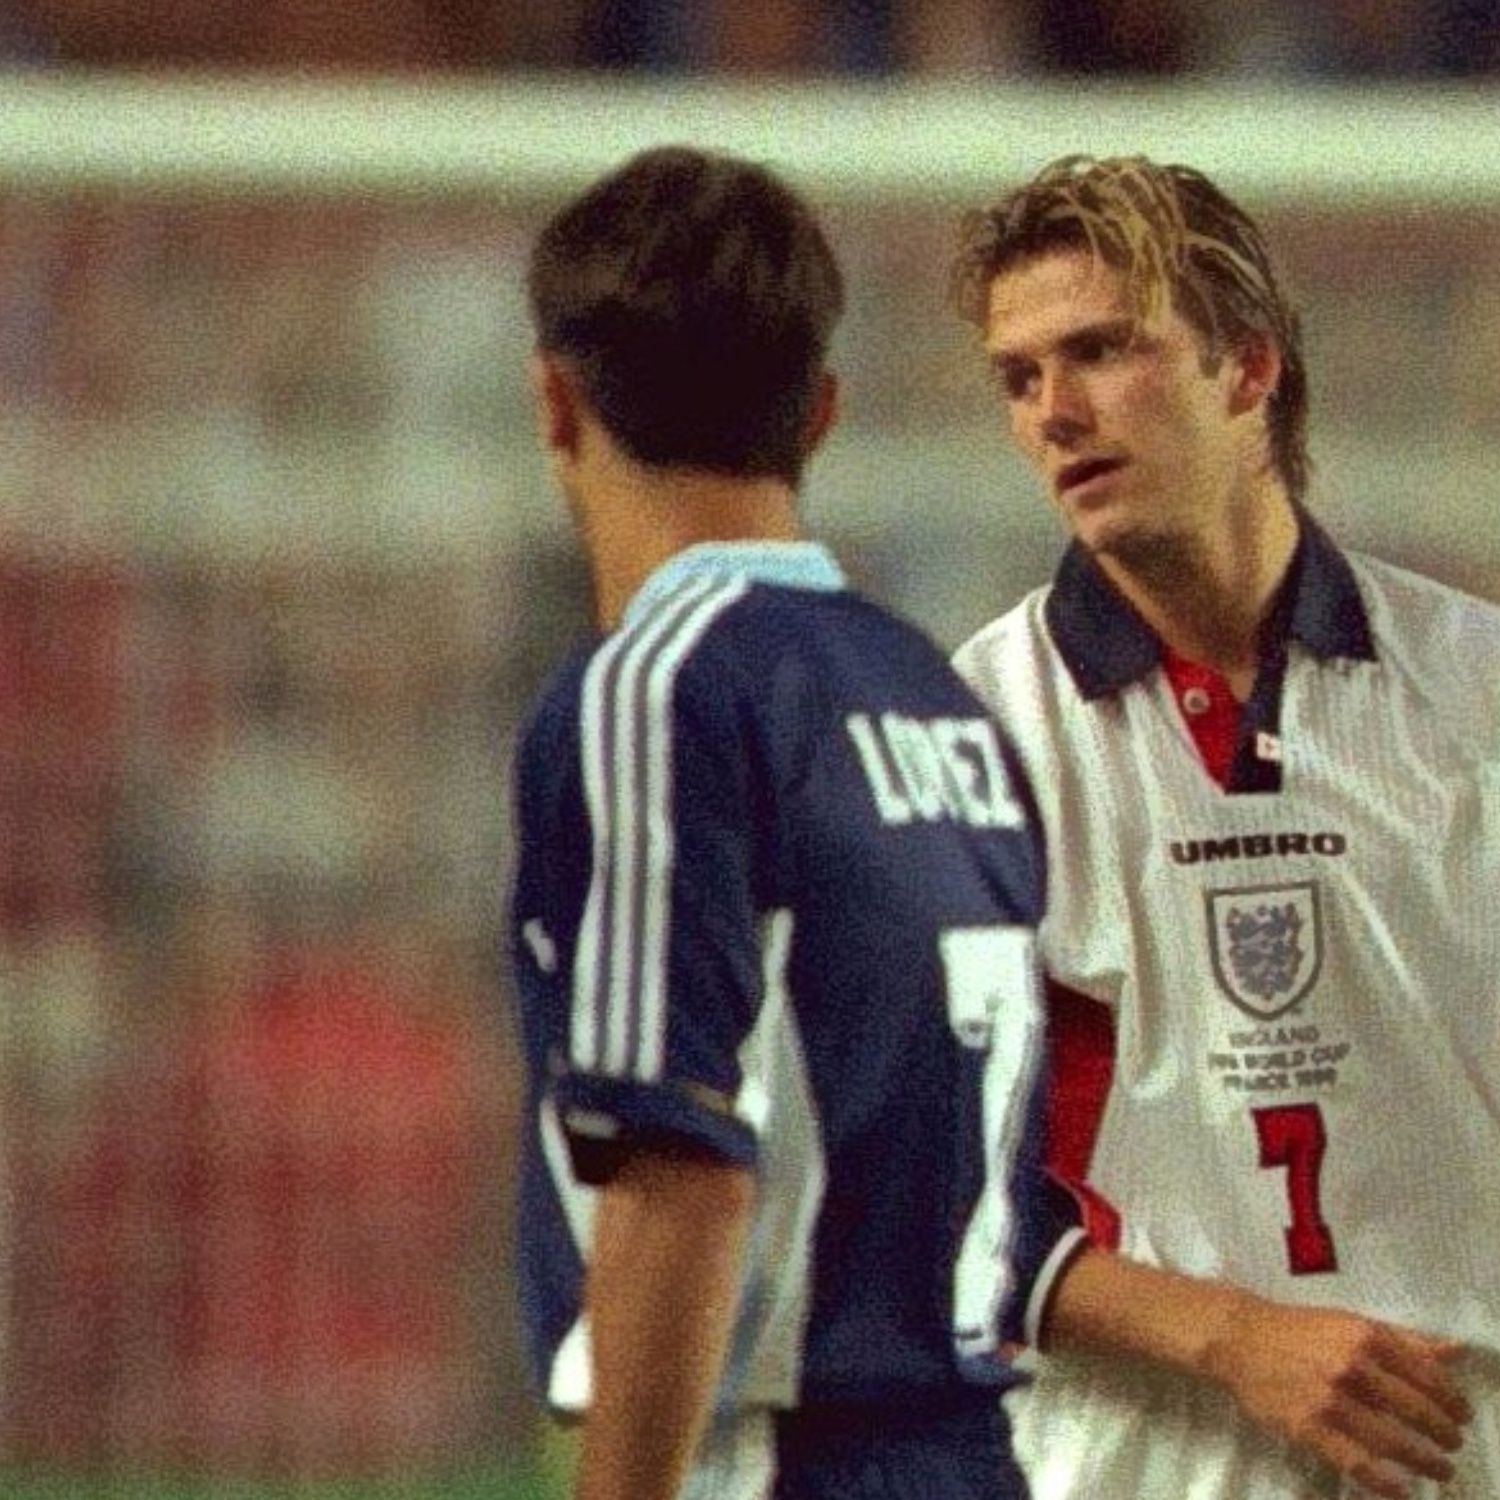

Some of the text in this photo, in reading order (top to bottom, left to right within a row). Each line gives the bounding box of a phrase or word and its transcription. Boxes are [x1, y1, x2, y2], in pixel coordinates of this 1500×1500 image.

[1170, 832, 1346, 865] UMBRO
[938, 925, 1044, 1354] 7
[1250, 1103, 1338, 1276] 7
